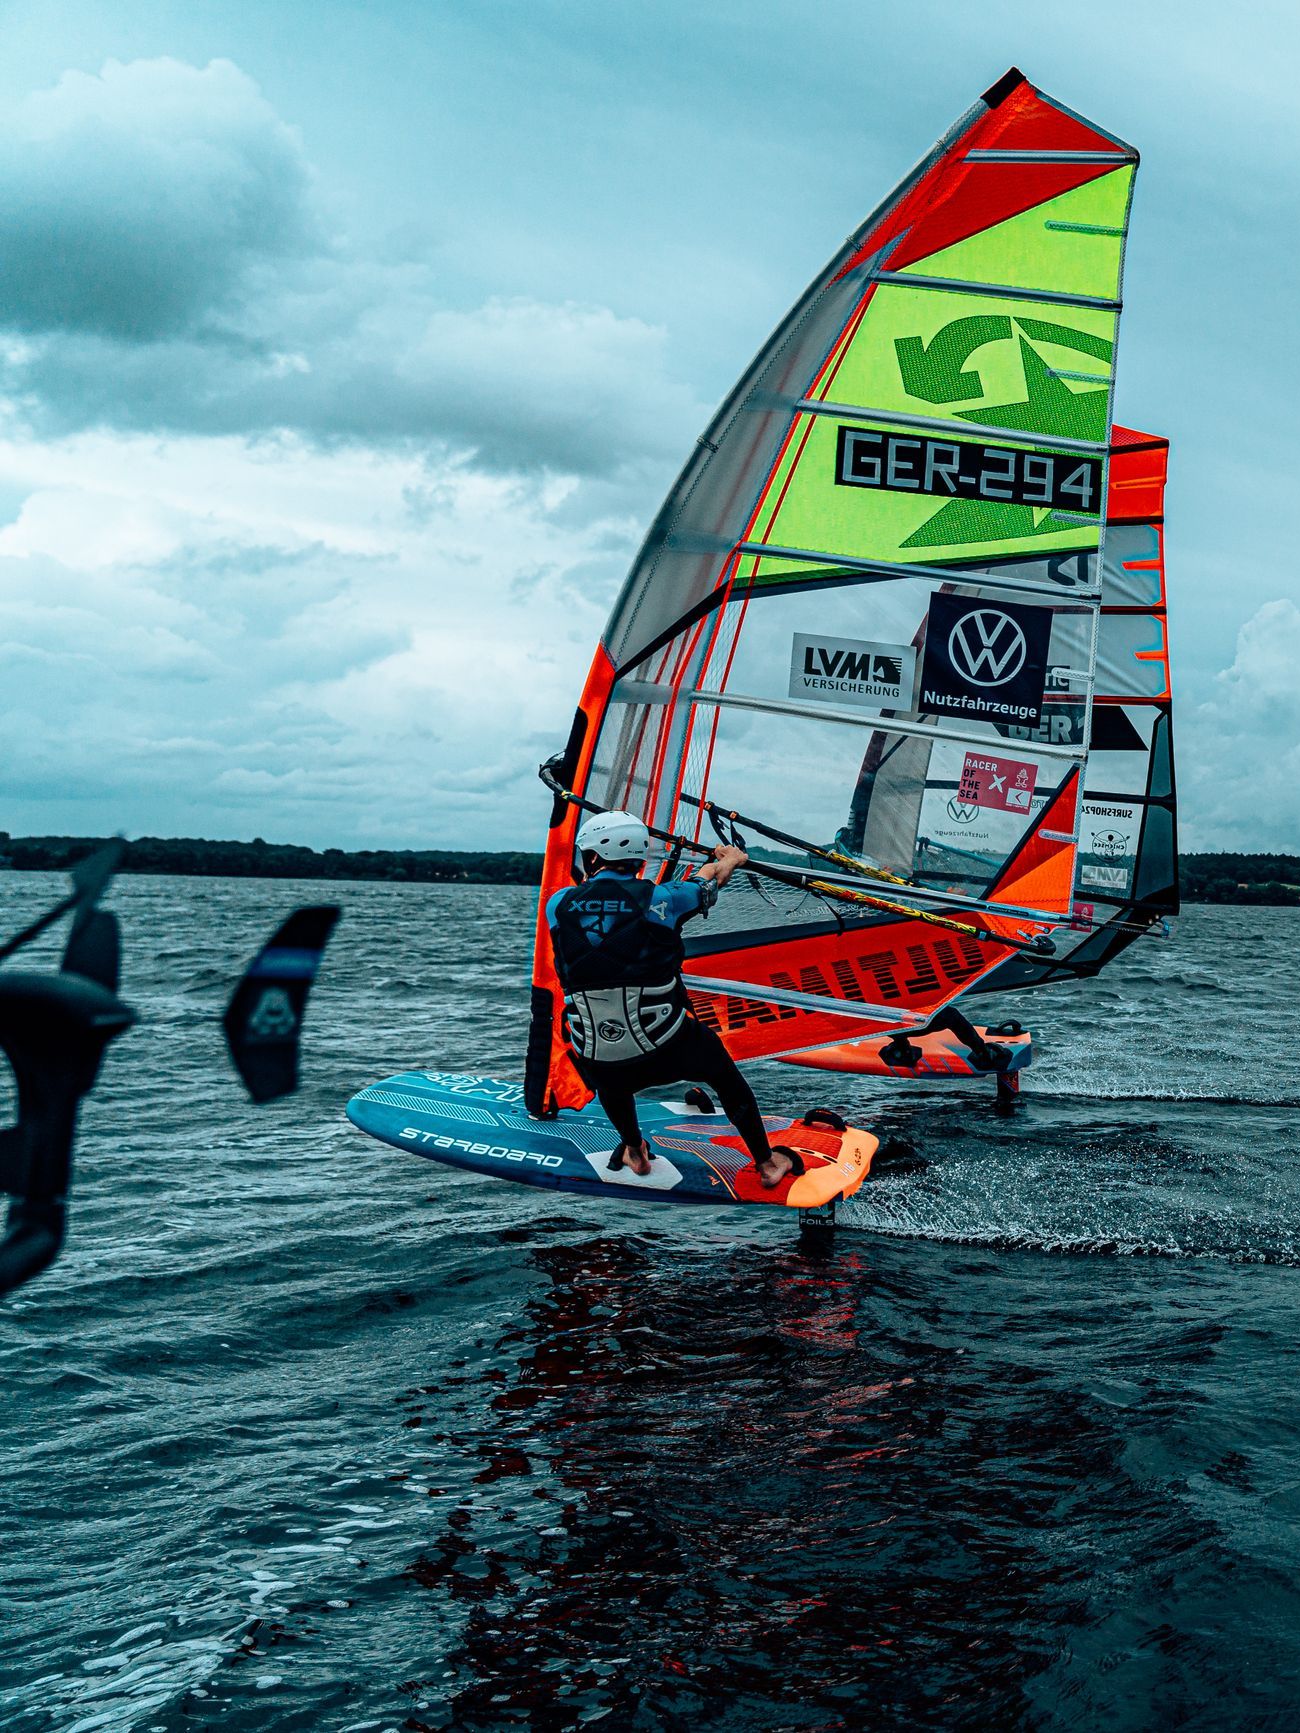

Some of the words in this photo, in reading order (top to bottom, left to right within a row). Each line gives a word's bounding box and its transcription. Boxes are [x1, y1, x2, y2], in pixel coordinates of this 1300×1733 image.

[842, 431, 1093, 508] GER-294
[804, 647, 871, 681] LVM
[803, 678, 900, 697] VERSICHERUNG
[923, 690, 1038, 719] Nutzfahrzeuge
[965, 758, 998, 772] RACER
[963, 769, 976, 778] OF
[961, 779, 980, 790] THE
[959, 790, 978, 800] SEA
[568, 900, 633, 912] XCEL
[800, 1218, 834, 1226] FOILS
